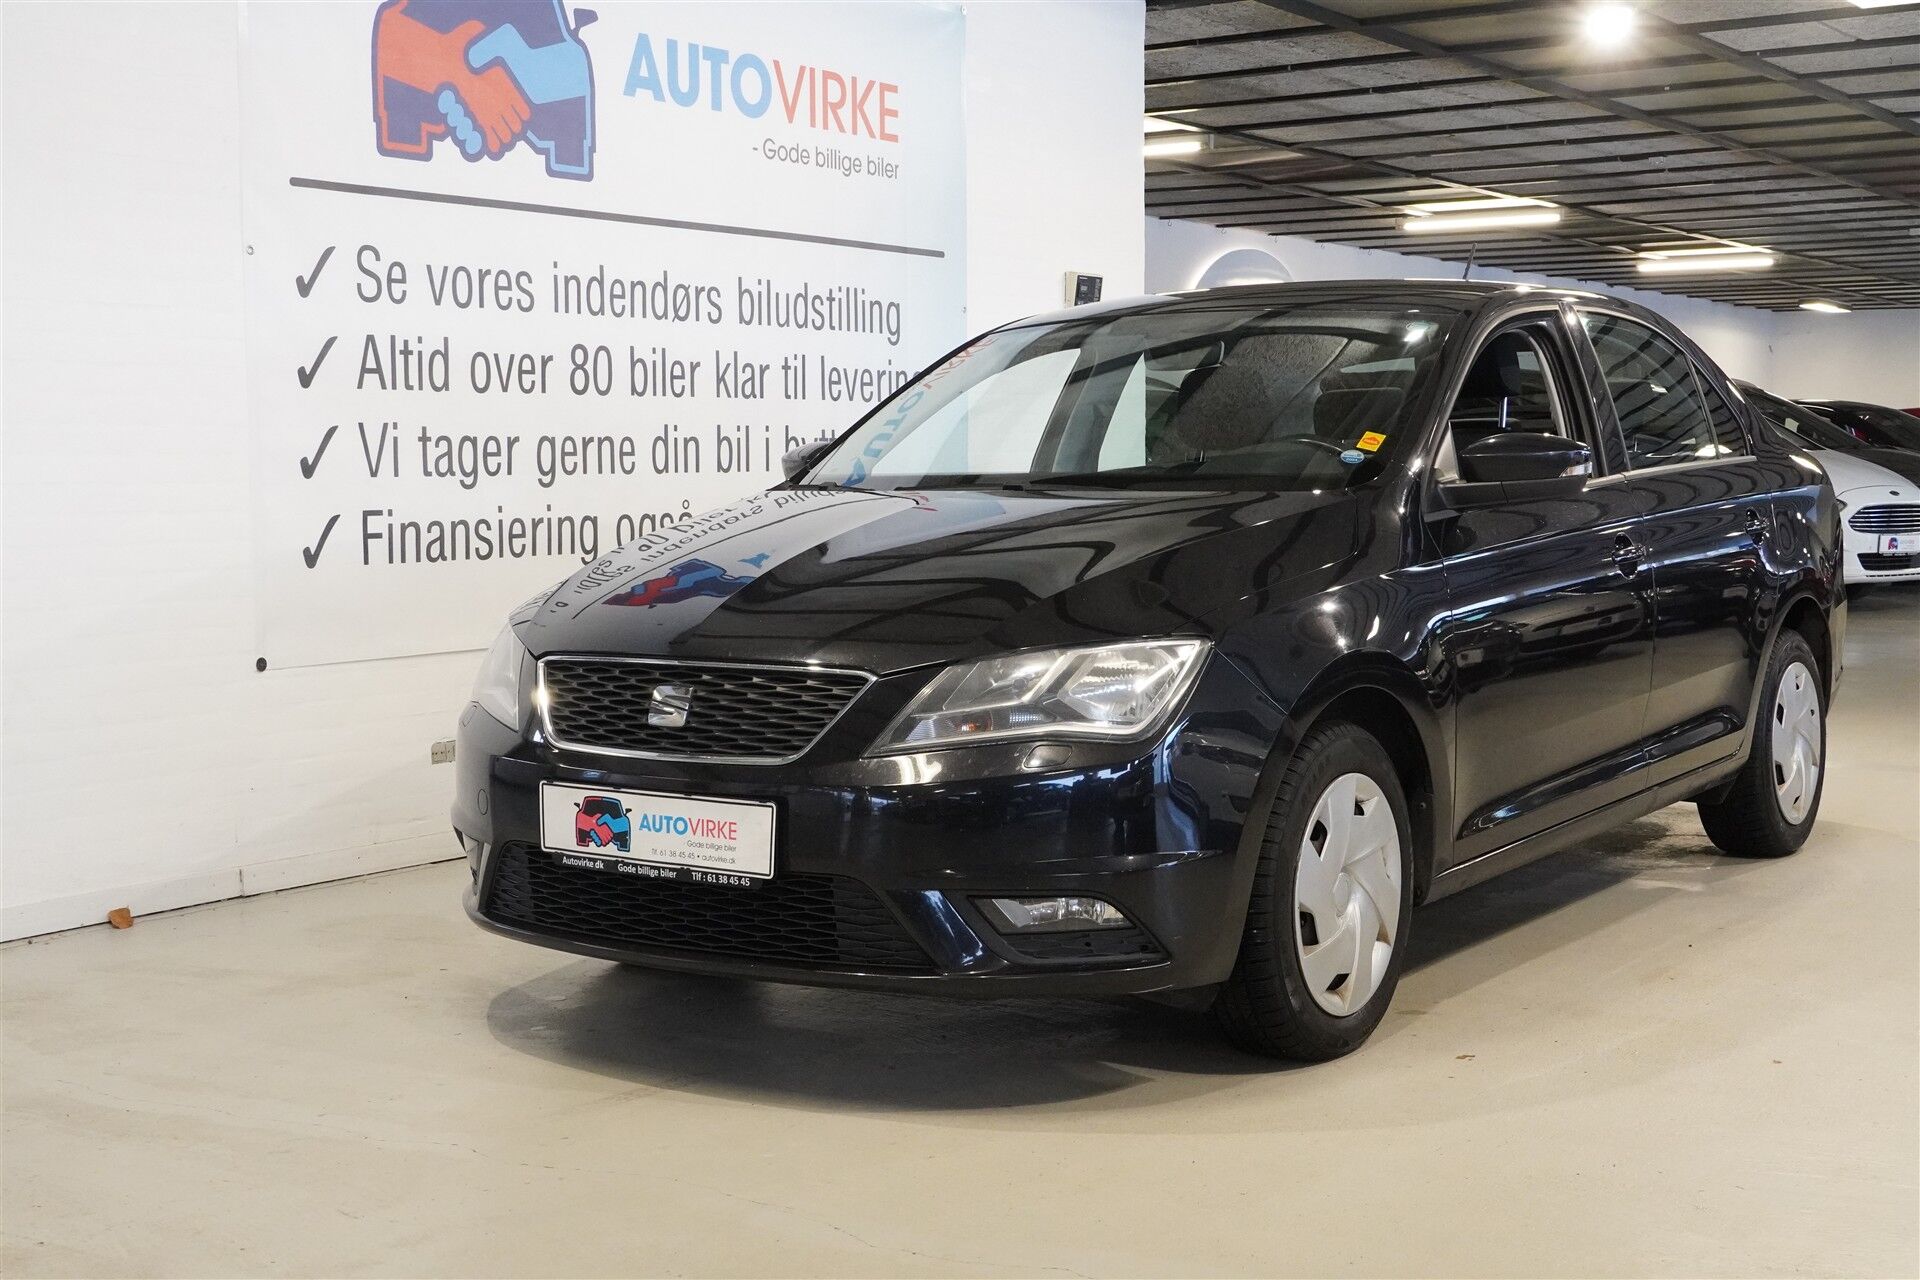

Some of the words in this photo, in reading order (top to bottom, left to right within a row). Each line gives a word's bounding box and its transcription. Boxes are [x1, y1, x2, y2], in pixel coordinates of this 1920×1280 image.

[623, 32, 900, 143] AUTOVIRKE
[762, 137, 811, 165] Gode
[814, 146, 862, 178] billige
[866, 152, 900, 179] biler
[356, 245, 406, 305] Se
[426, 264, 535, 313] vores
[553, 262, 725, 326] indendørs
[737, 276, 901, 347] biludstilling
[357, 334, 450, 393] Altid
[471, 351, 554, 399] over
[570, 344, 613, 397] 80
[630, 346, 701, 399] biler
[715, 350, 771, 400] klar
[781, 354, 806, 400] til
[820, 355, 923, 403] leverin
[357, 421, 400, 479] Vi
[418, 425, 521, 491] tager
[537, 435, 636, 489] gerne
[651, 424, 700, 475] din
[716, 425, 751, 474] bil
[765, 424, 771, 473] i
[362, 504, 599, 566] Finansiering
[639, 813, 737, 841] AUTOVIRKE
[687, 840, 704, 849] Gode
[705, 842, 723, 852] billige
[724, 843, 736, 853] biler
[617, 863, 636, 873] Gode
[638, 865, 659, 877] billige
[660, 868, 678, 878] biler
[707, 873, 716, 883] 61
[718, 875, 728, 884] 38
[730, 876, 739, 885] 45
[740, 877, 750, 886] 45
[660, 849, 667, 857] 61
[669, 850, 676, 858] 38
[678, 851, 686, 859] 45
